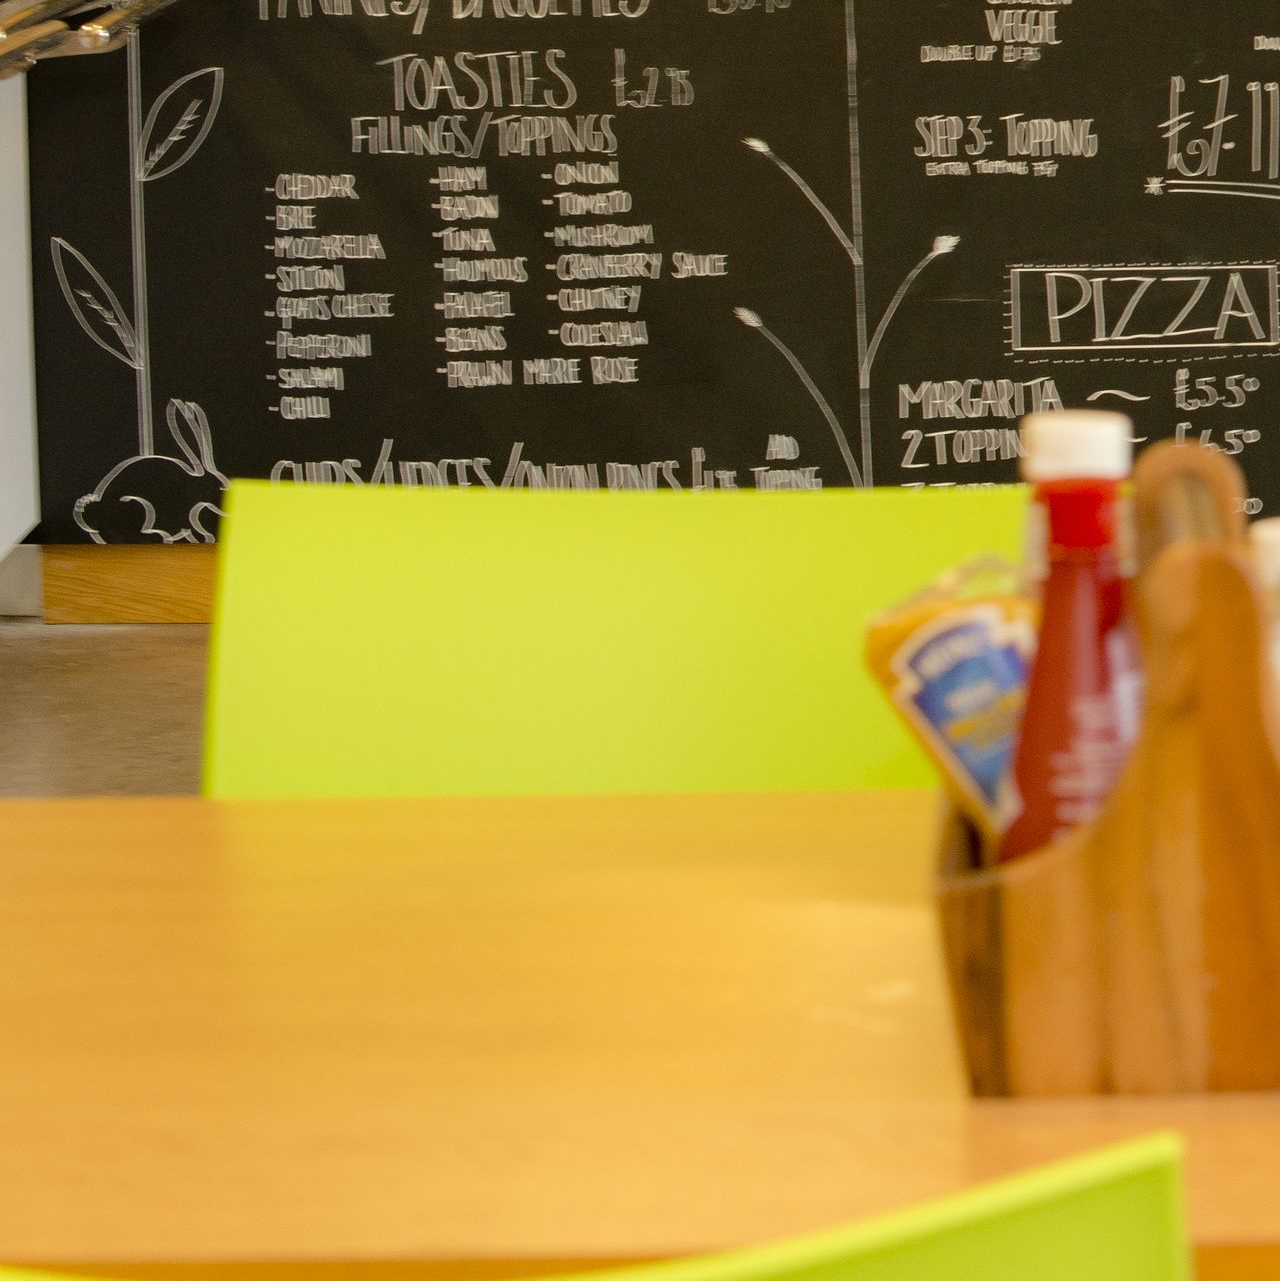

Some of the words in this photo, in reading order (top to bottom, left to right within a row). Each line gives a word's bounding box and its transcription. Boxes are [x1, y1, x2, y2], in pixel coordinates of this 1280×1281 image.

[984, 9, 1063, 45] VEGGIE
[376, 49, 577, 110] TOASTIES
[914, 114, 963, 157] STEP
[999, 113, 1098, 157] TOPPING
[1045, 272, 1266, 343] PIZZA
[899, 376, 1064, 419] MARGARITA
[900, 429, 930, 468] 2
